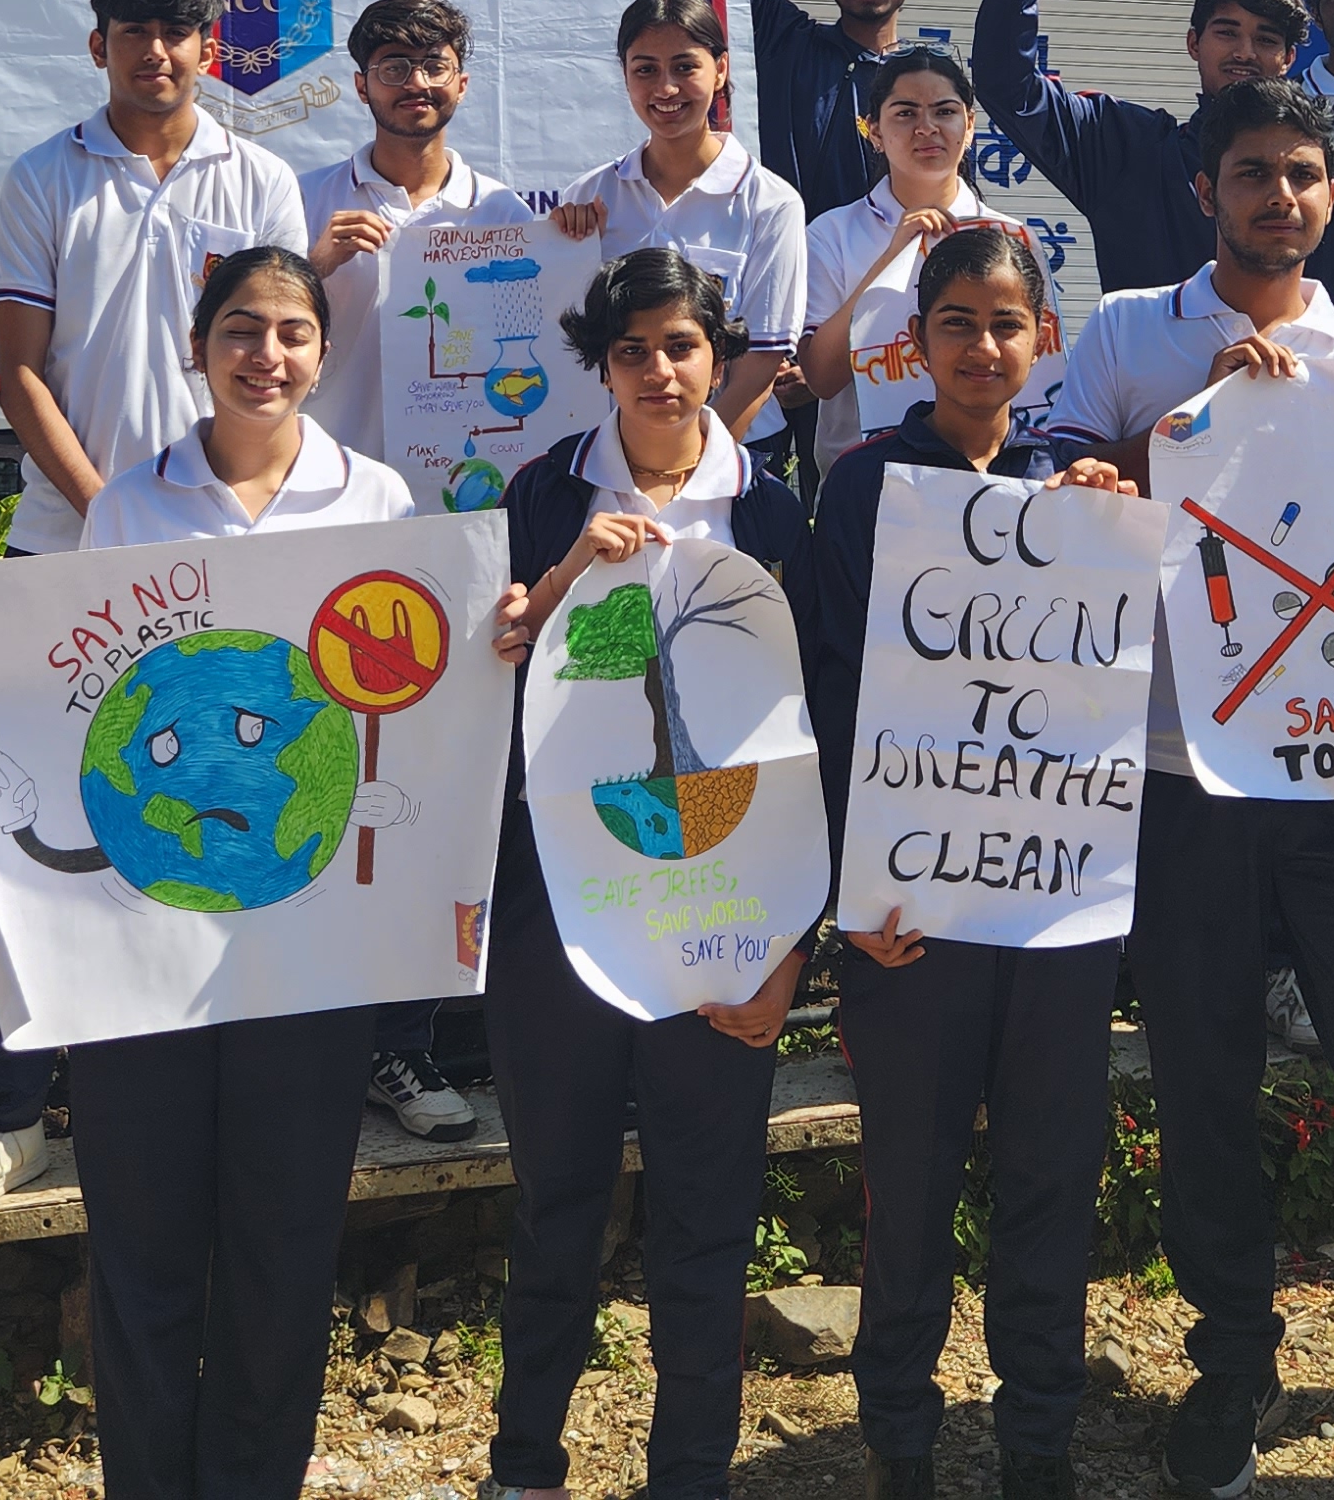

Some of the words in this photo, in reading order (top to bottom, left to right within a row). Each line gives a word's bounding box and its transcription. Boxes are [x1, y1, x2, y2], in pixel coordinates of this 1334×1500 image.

[423, 244, 524, 264] HARVESTING
[428, 226, 531, 249] RAINWATER
[405, 405, 414, 416] IT
[440, 400, 463, 412] SAVE
[466, 399, 485, 414] YOU
[408, 380, 433, 393] SAVE
[406, 444, 440, 458] MAKE
[424, 456, 453, 469] EVERY
[489, 442, 525, 455] COUNT
[47, 598, 123, 684] SAY
[131, 558, 212, 618] NO!
[902, 566, 1128, 669] GREEN
[65, 672, 106, 715] TO
[103, 609, 215, 673] PLASTIC
[963, 679, 1049, 740] TO
[862, 728, 1137, 813] BREATHE
[579, 872, 642, 915] SAVE
[649, 859, 739, 902] TREES,
[887, 830, 1094, 897] CLEAN
[645, 908, 694, 942] SAVE
[696, 896, 769, 935] WORLD,
[681, 933, 726, 967] SAVE
